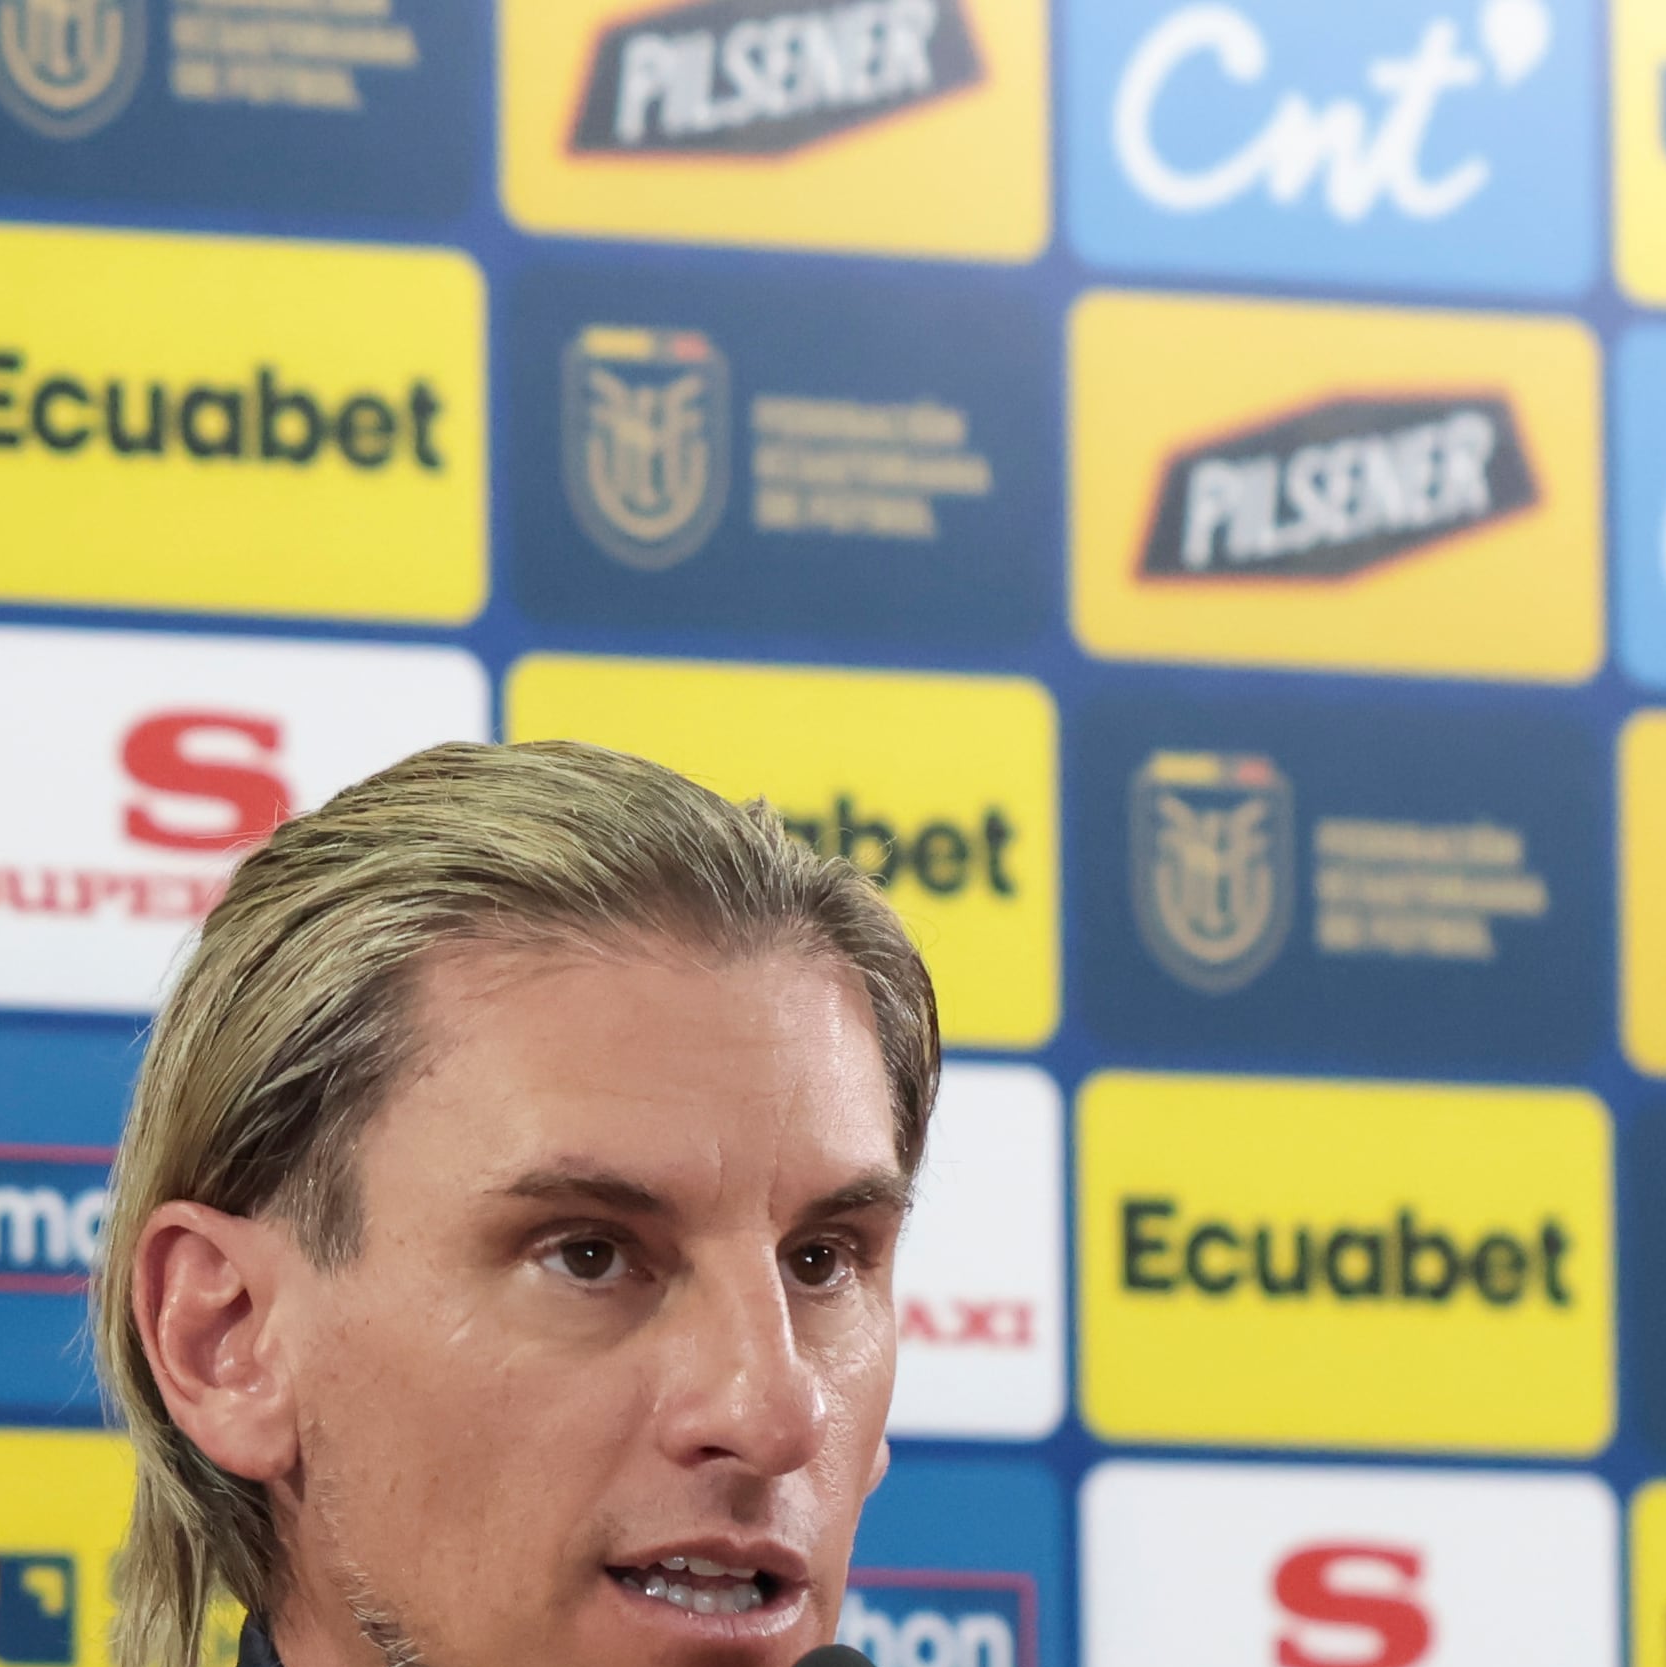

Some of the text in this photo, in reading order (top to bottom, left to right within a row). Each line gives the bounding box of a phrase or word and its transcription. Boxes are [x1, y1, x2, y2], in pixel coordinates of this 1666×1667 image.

[619, 0, 939, 140] PILSENER
[1184, 411, 1495, 565] PILSENER
[1118, 1196, 1572, 1309] Ecuabet
